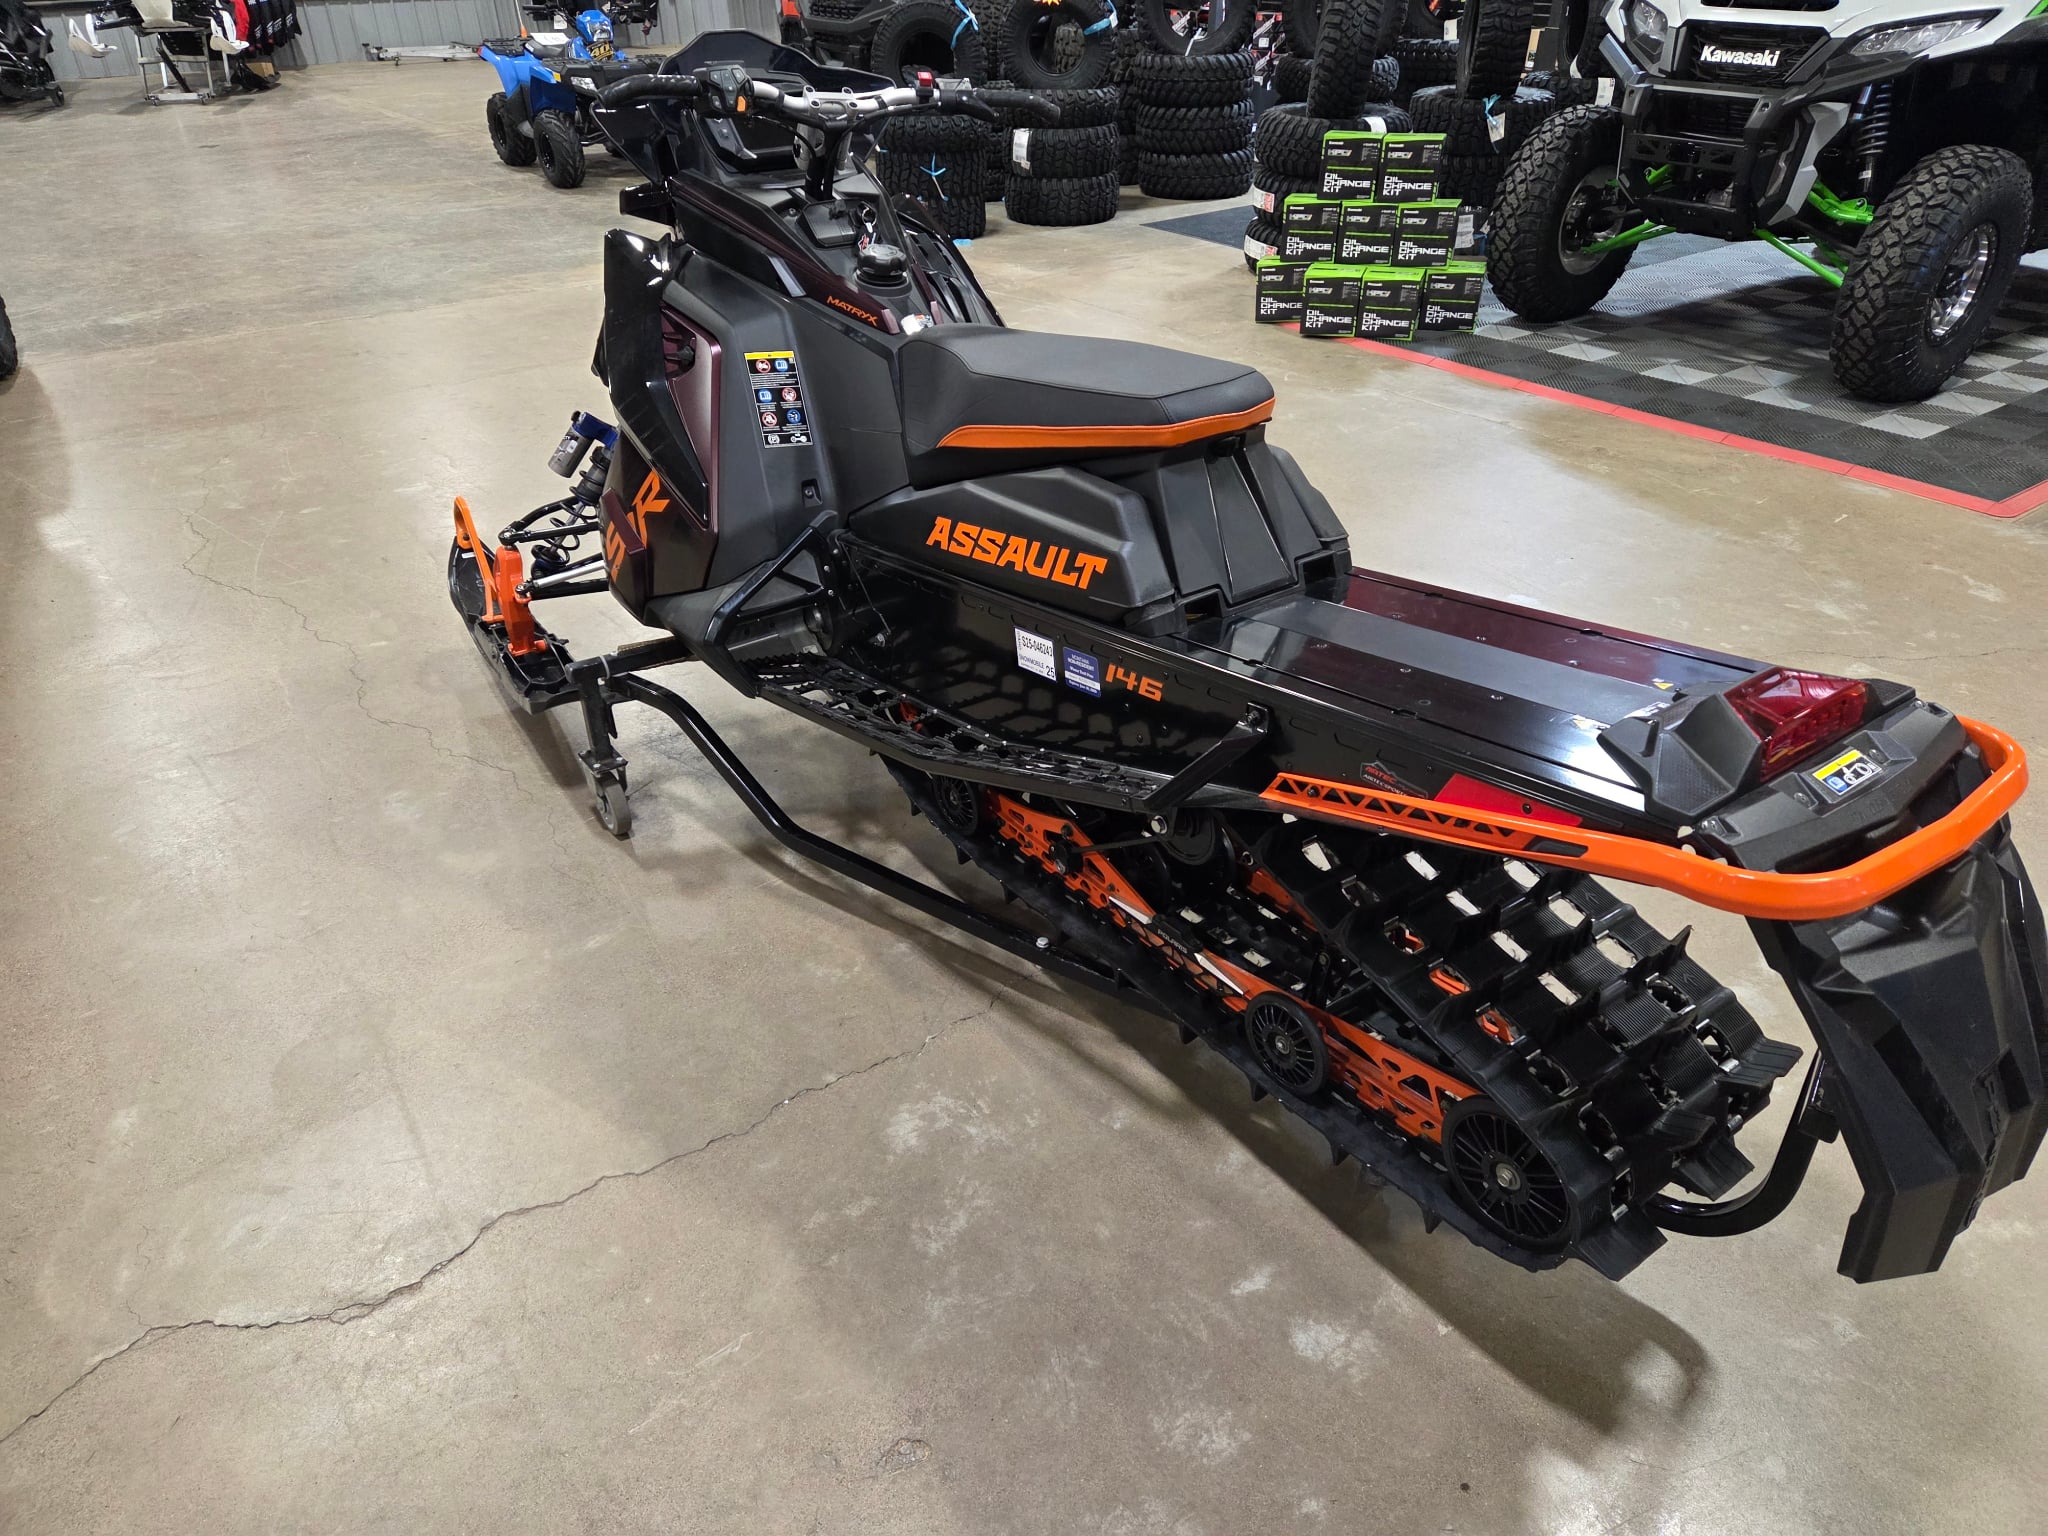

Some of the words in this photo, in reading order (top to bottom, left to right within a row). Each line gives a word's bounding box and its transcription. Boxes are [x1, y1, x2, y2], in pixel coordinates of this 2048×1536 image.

[1700, 45, 1780, 67] Kawasaki
[1324, 179, 1371, 188] CHANGE
[1384, 182, 1432, 190] CHANGE
[1343, 244, 1389, 253] CHANGE
[1399, 246, 1447, 255] CHANGE
[826, 296, 878, 327] MATRYX
[1426, 311, 1473, 319] CHANGE
[1306, 315, 1352, 324] CHANGE
[1362, 318, 1409, 327] CHANGE
[926, 516, 1108, 590] ASSAULT
[1046, 665, 1056, 678] 25
[1105, 662, 1164, 702] 146
[1157, 929, 1188, 954] POLARIS
